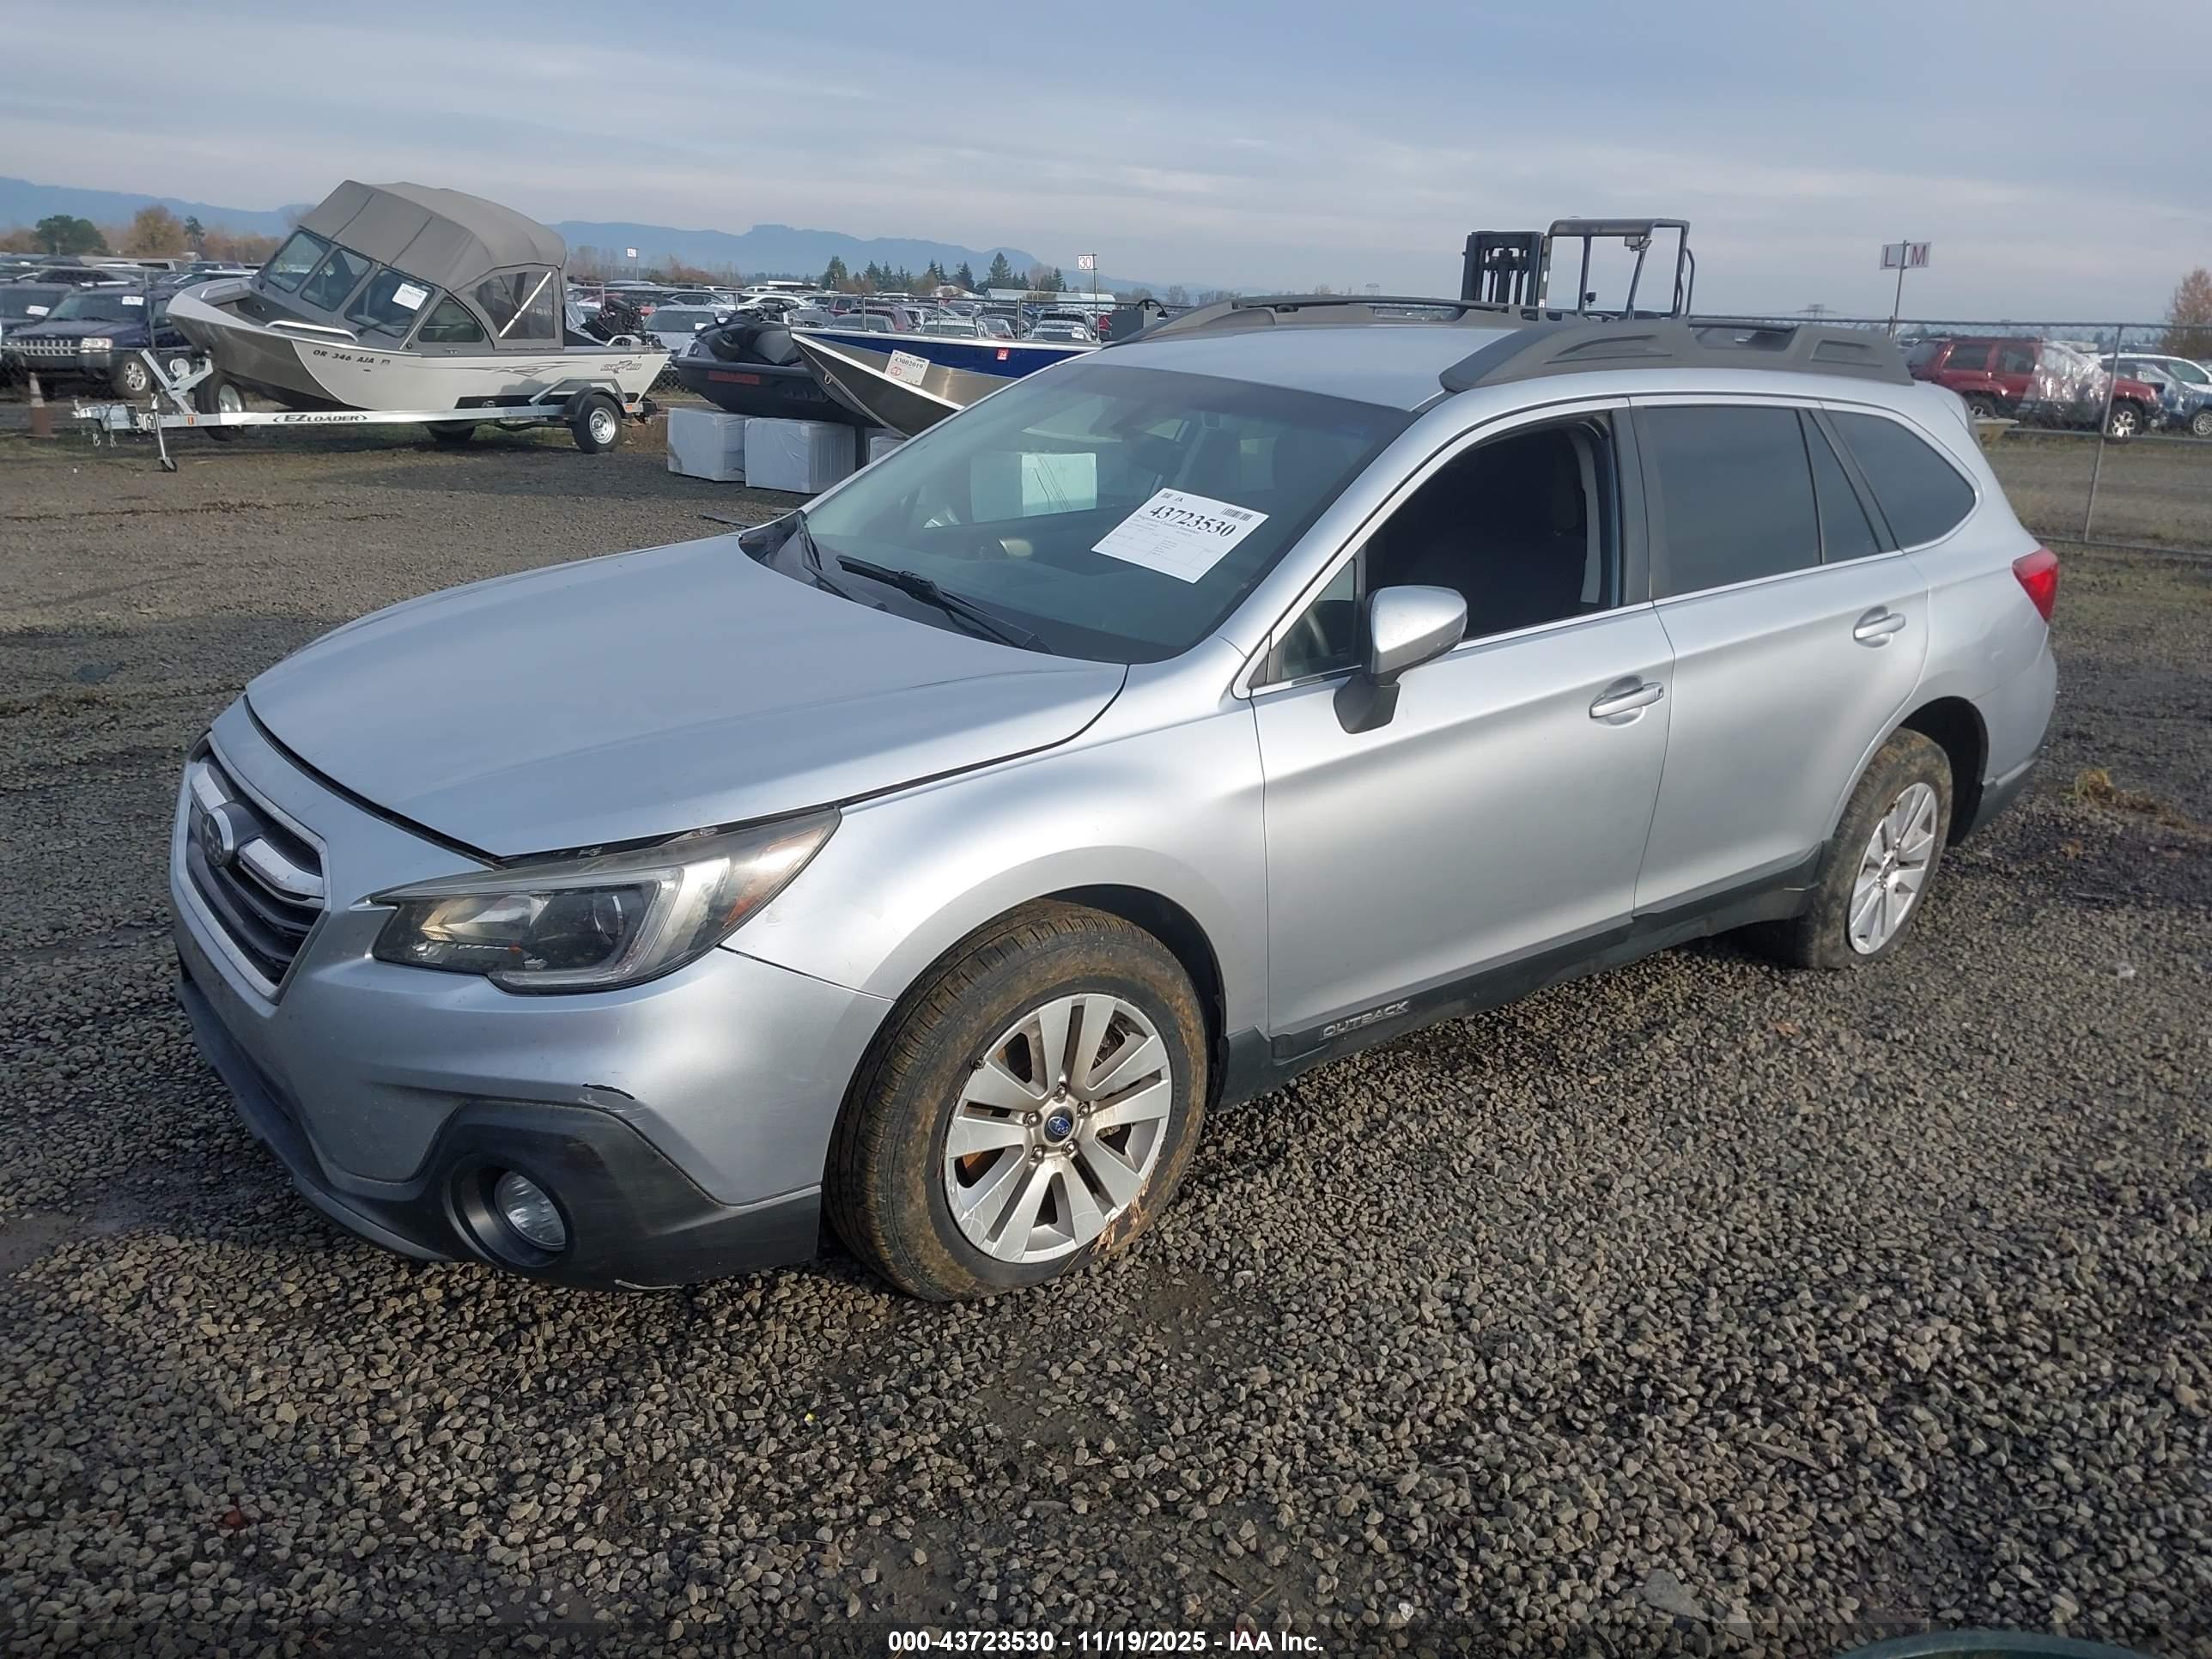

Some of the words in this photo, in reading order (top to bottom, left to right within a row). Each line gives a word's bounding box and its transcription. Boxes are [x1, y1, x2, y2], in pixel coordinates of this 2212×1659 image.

[1079, 256, 1091, 269] 30
[1884, 246, 1896, 267] L
[1911, 245, 1927, 266] M
[313, 349, 328, 357] OR
[331, 352, 352, 362] 346
[1149, 505, 1237, 538] 43723530
[1322, 1000, 1410, 1039] OUTBACK
